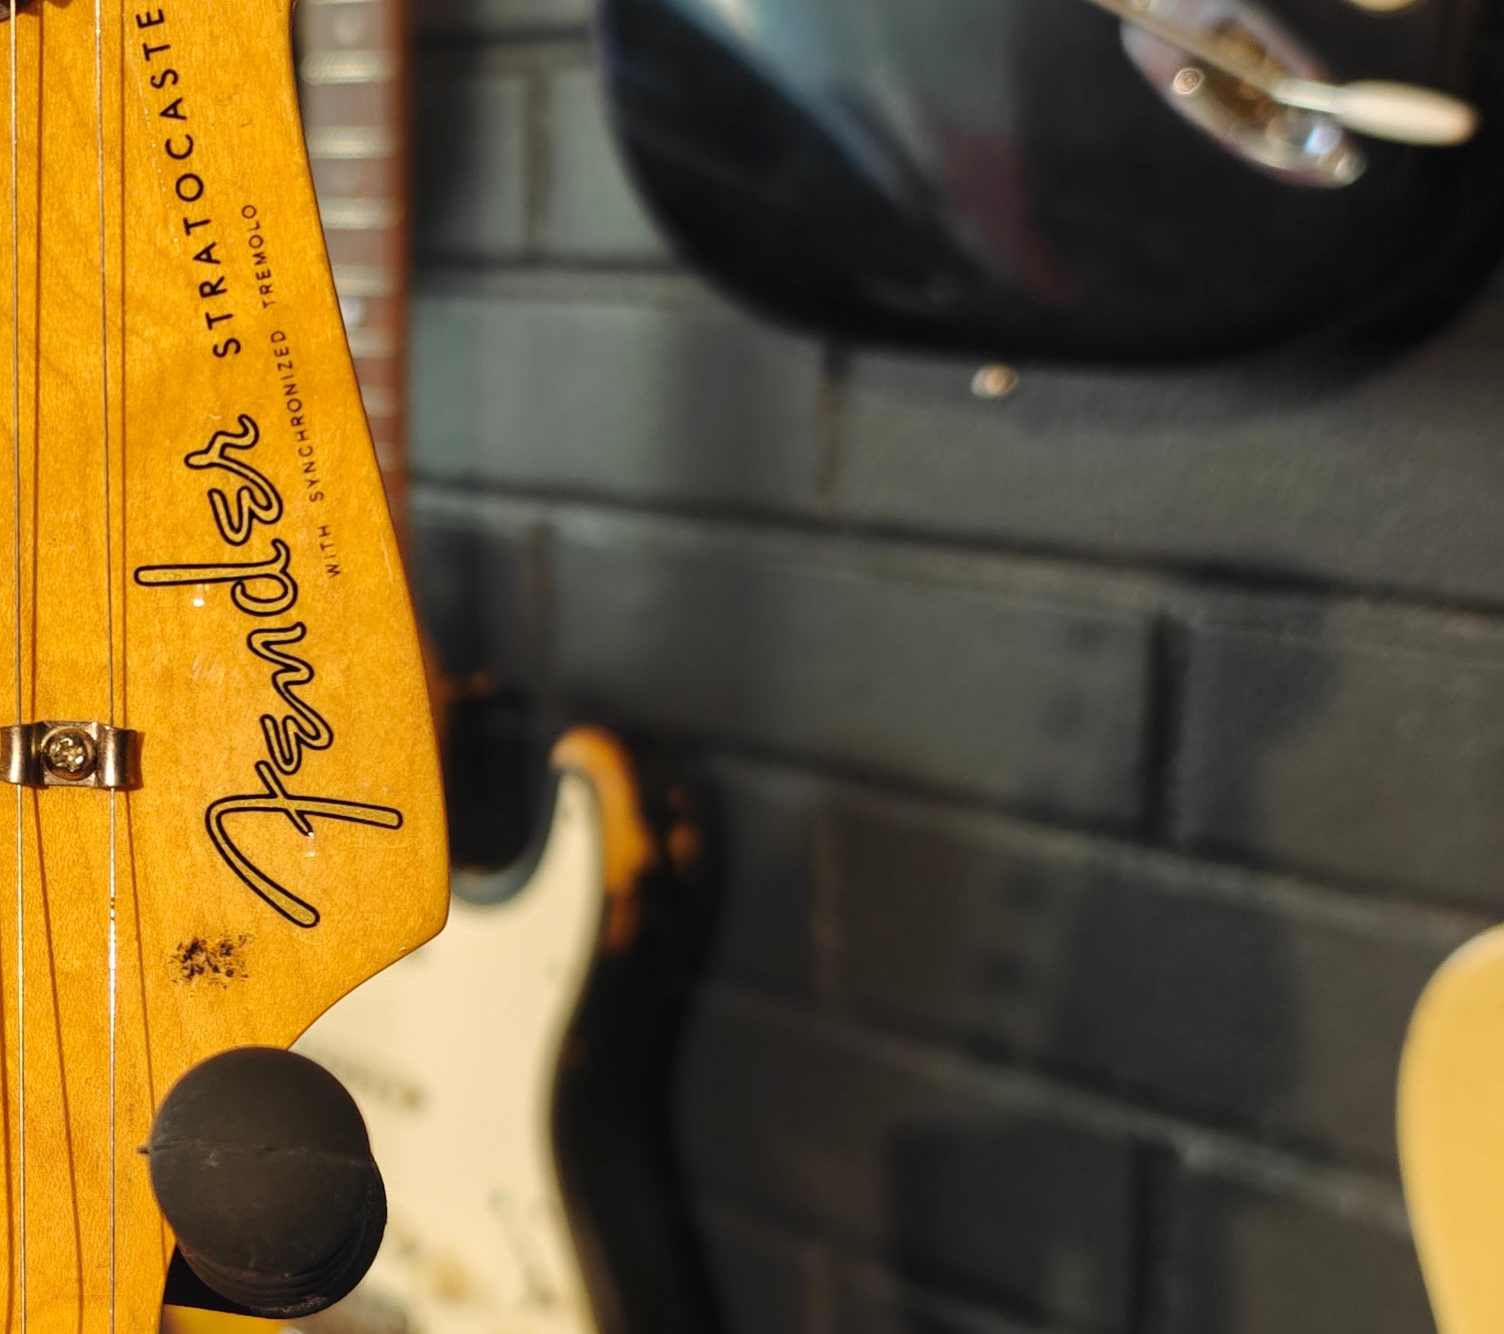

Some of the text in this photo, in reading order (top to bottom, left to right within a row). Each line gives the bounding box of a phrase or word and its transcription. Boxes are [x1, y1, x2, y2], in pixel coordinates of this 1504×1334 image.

[241, 204, 341, 579] WITH SYNCHRONIZED TREMOLO
[134, 414, 404, 929] Fender
